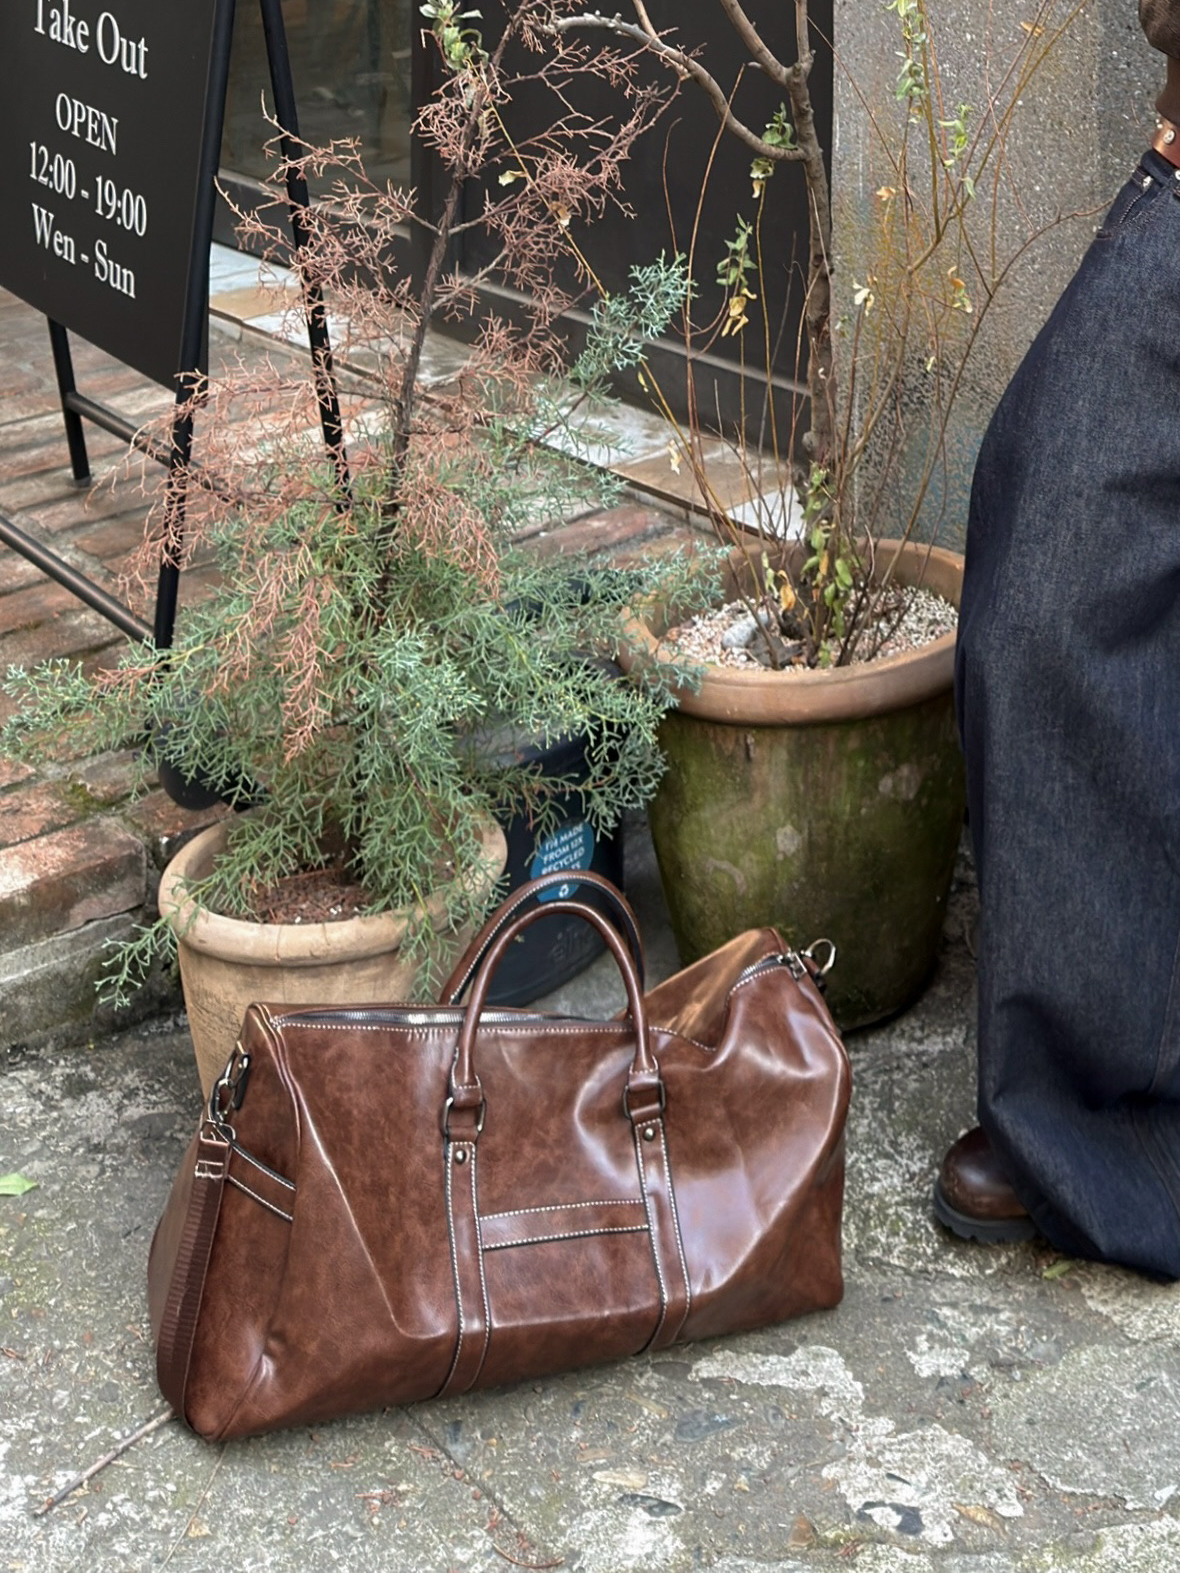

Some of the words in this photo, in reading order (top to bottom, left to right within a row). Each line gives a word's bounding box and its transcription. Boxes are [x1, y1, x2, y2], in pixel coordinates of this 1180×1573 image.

[97, 11, 148, 79] Out
[56, 92, 119, 156] OPEN
[29, 140, 76, 200] 12:00
[95, 175, 147, 237] 19:00
[31, 202, 76, 265] Wen
[94, 238, 136, 299] Sun
[543, 844, 570, 866] FROM
[559, 822, 584, 845] MADE
